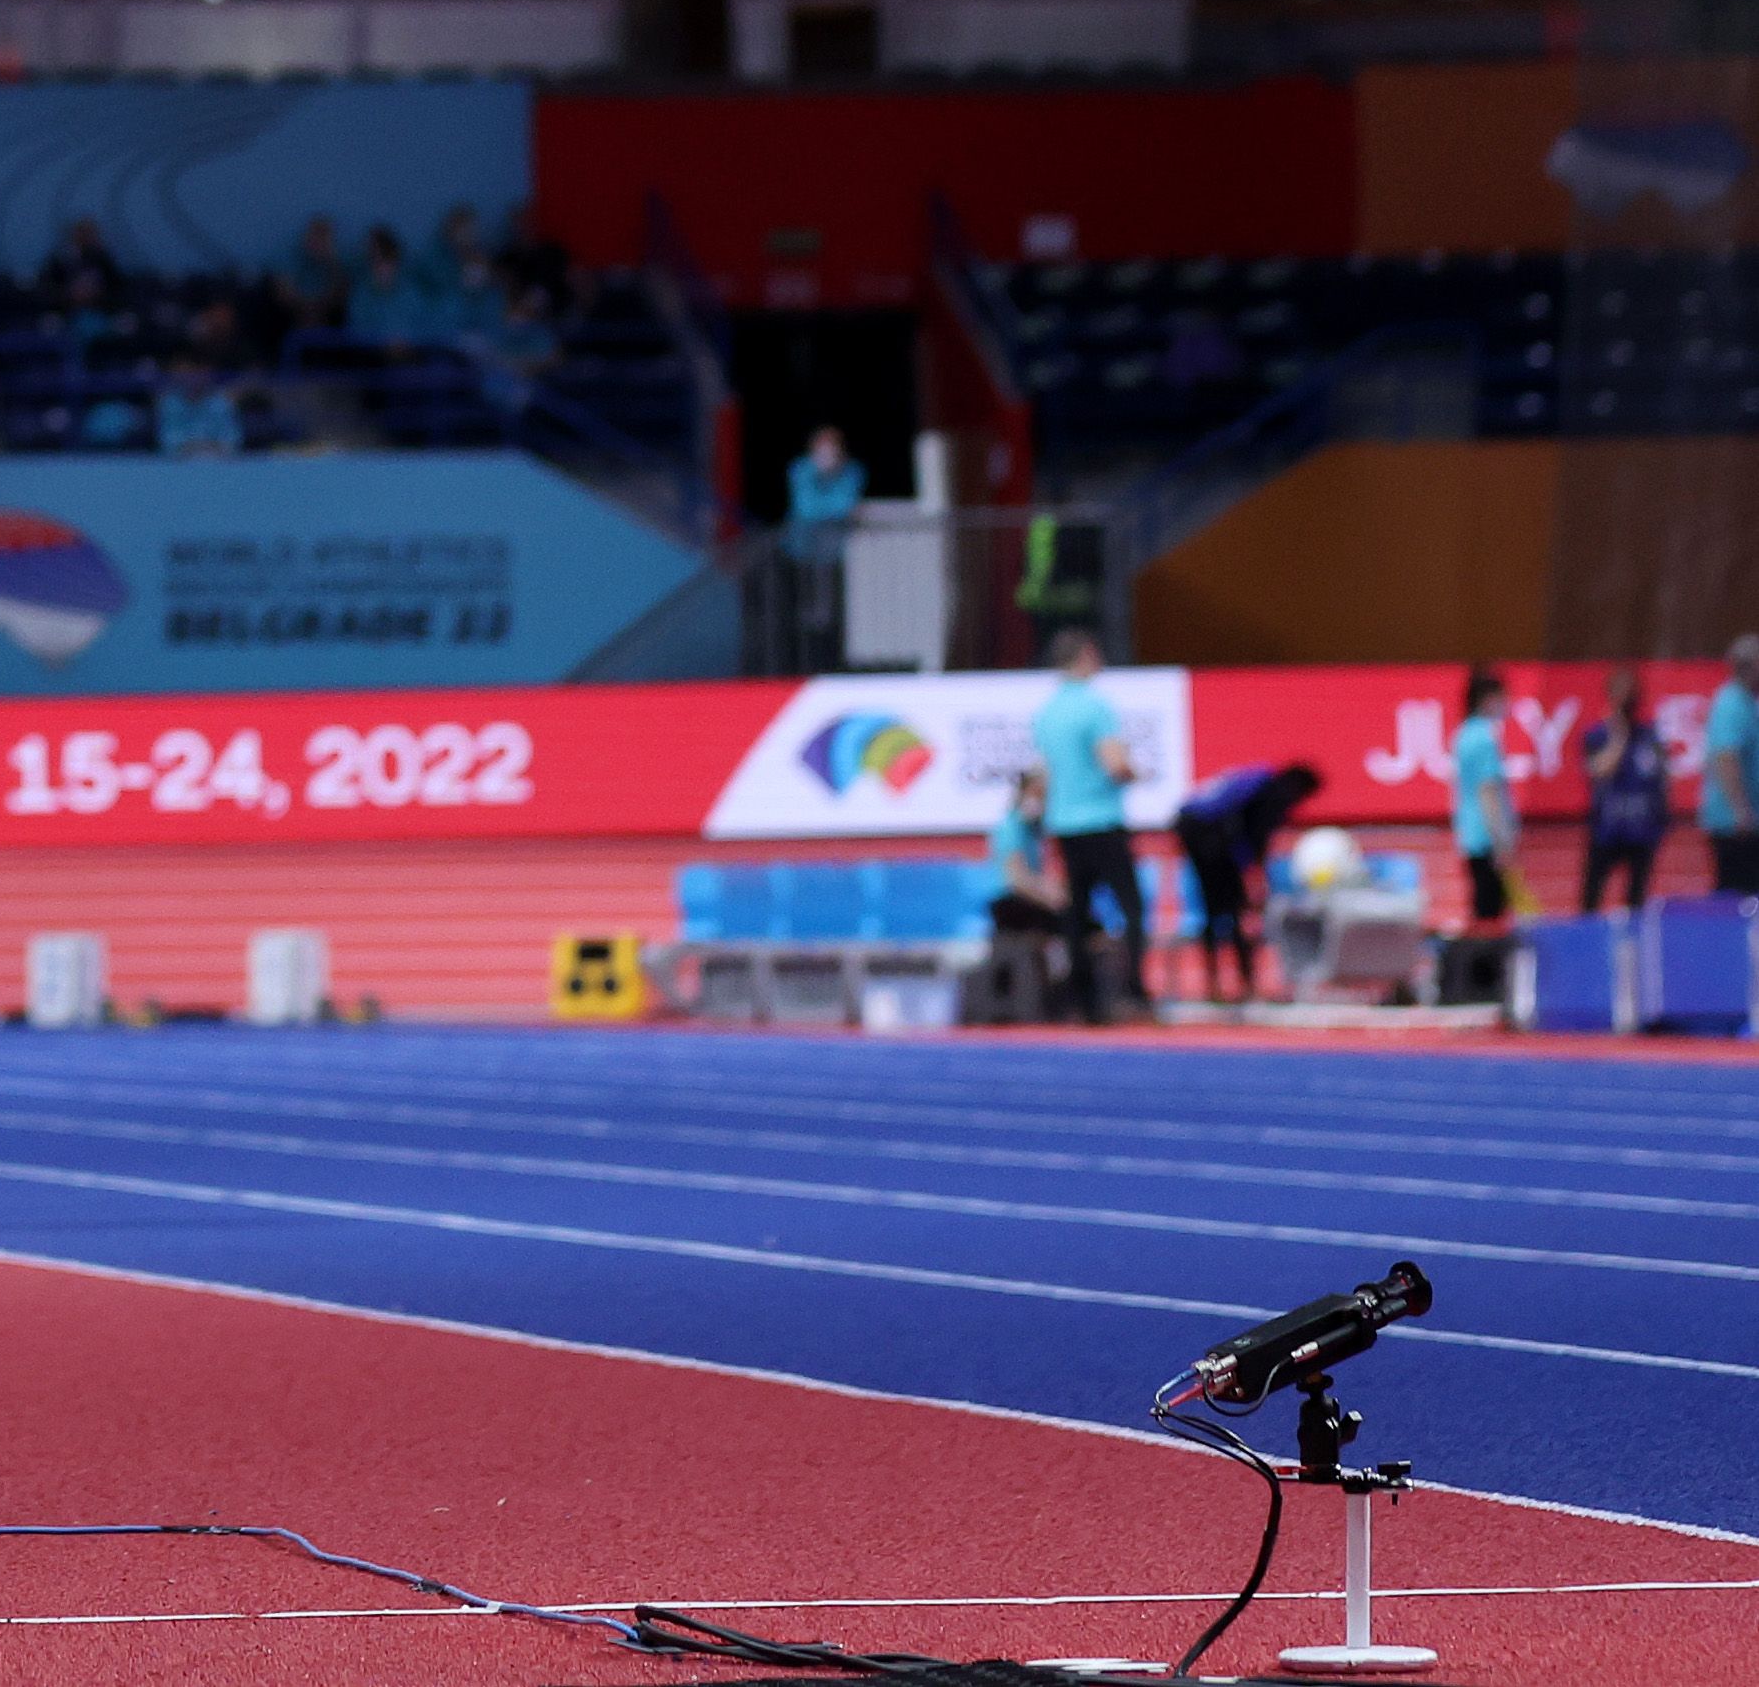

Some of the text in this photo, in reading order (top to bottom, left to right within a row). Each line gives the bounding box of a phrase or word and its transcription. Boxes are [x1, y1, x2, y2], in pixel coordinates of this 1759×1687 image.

[5, 728, 292, 819] 15-24,
[303, 721, 534, 807] 2022
[1362, 697, 1580, 785] JUY
